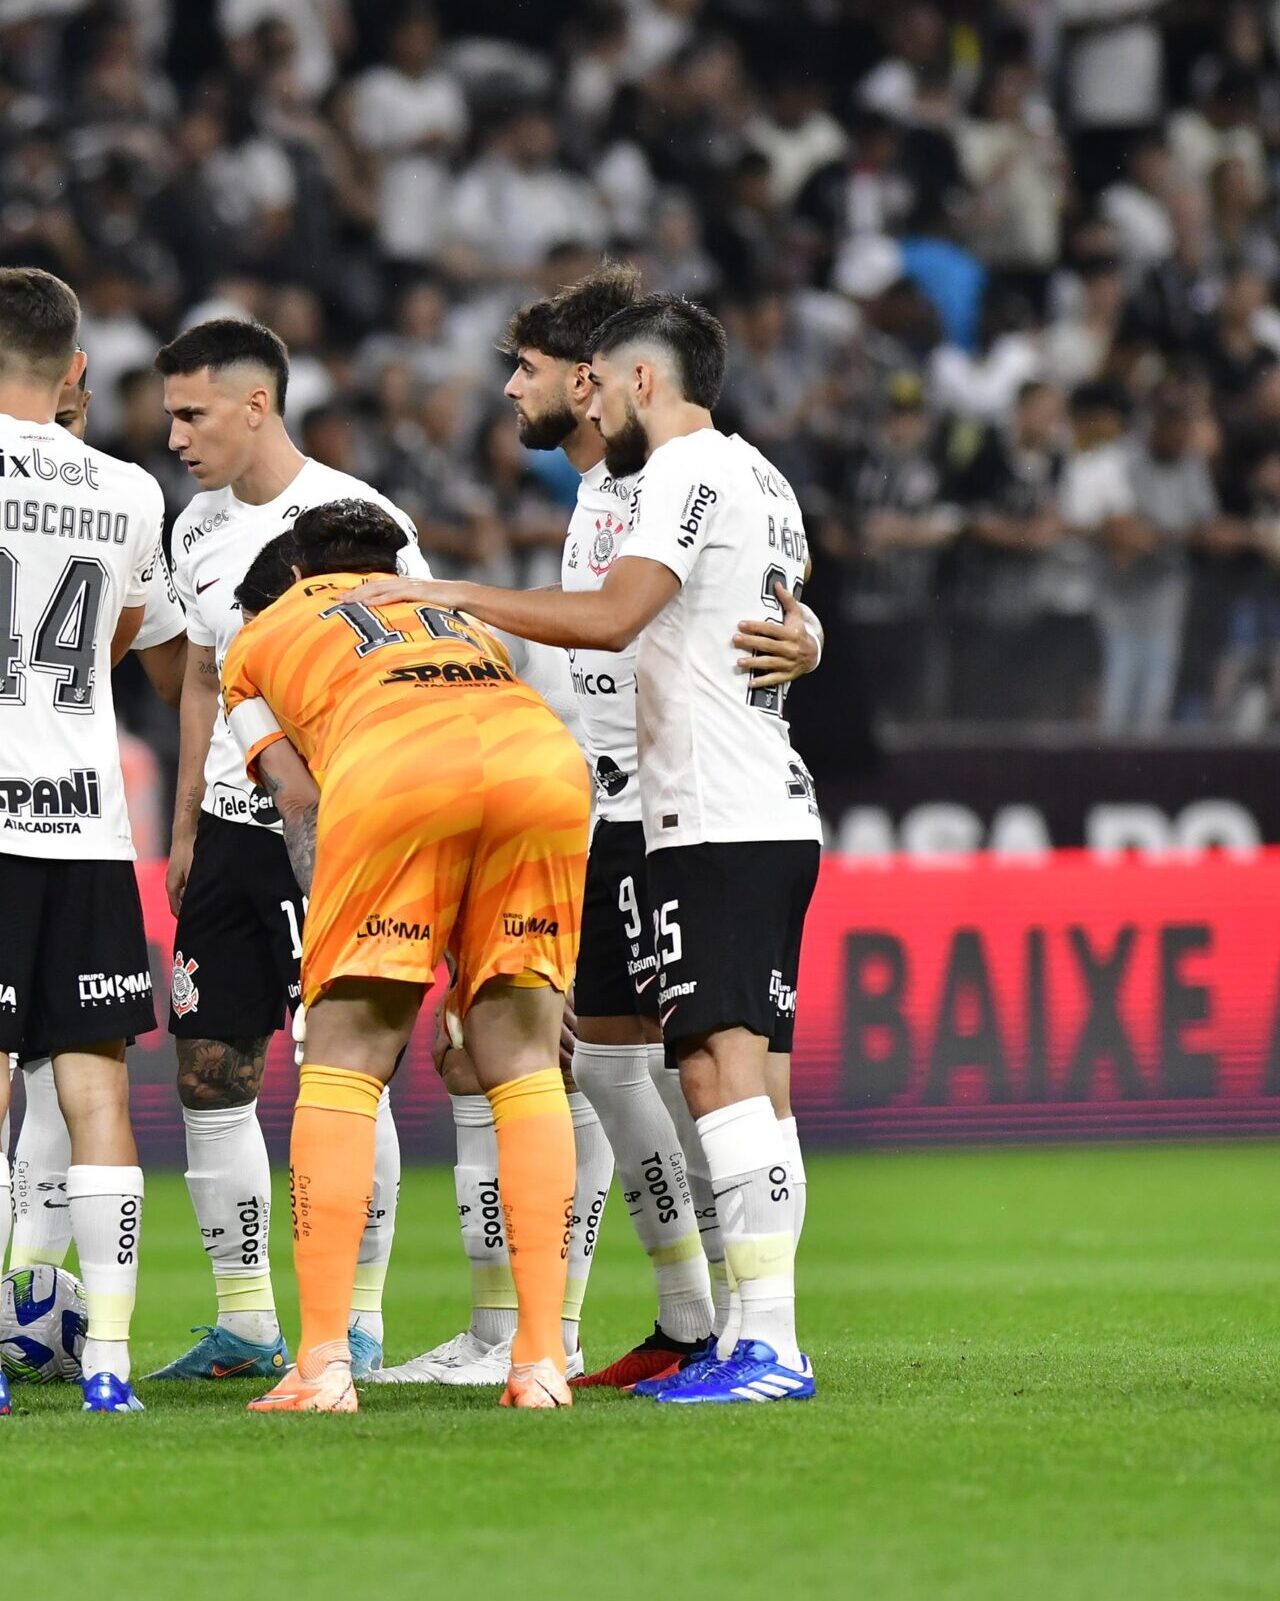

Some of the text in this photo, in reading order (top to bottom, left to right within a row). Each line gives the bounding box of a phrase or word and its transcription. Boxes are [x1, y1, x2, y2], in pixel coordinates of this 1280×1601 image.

[680, 483, 717, 536] bmg
[4, 818, 81, 834] ATACADISTA
[219, 796, 247, 817] Tele
[824, 801, 1054, 868] ASA
[280, 896, 309, 960] 1
[618, 875, 642, 939] 9
[843, 925, 1216, 1102] BAIXE
[479, 1178, 503, 1248] TODOS
[641, 1152, 678, 1223] TODOS
[117, 1195, 137, 1264] ODOS
[237, 1196, 259, 1264] TODOS
[584, 1189, 608, 1256] TODOS
